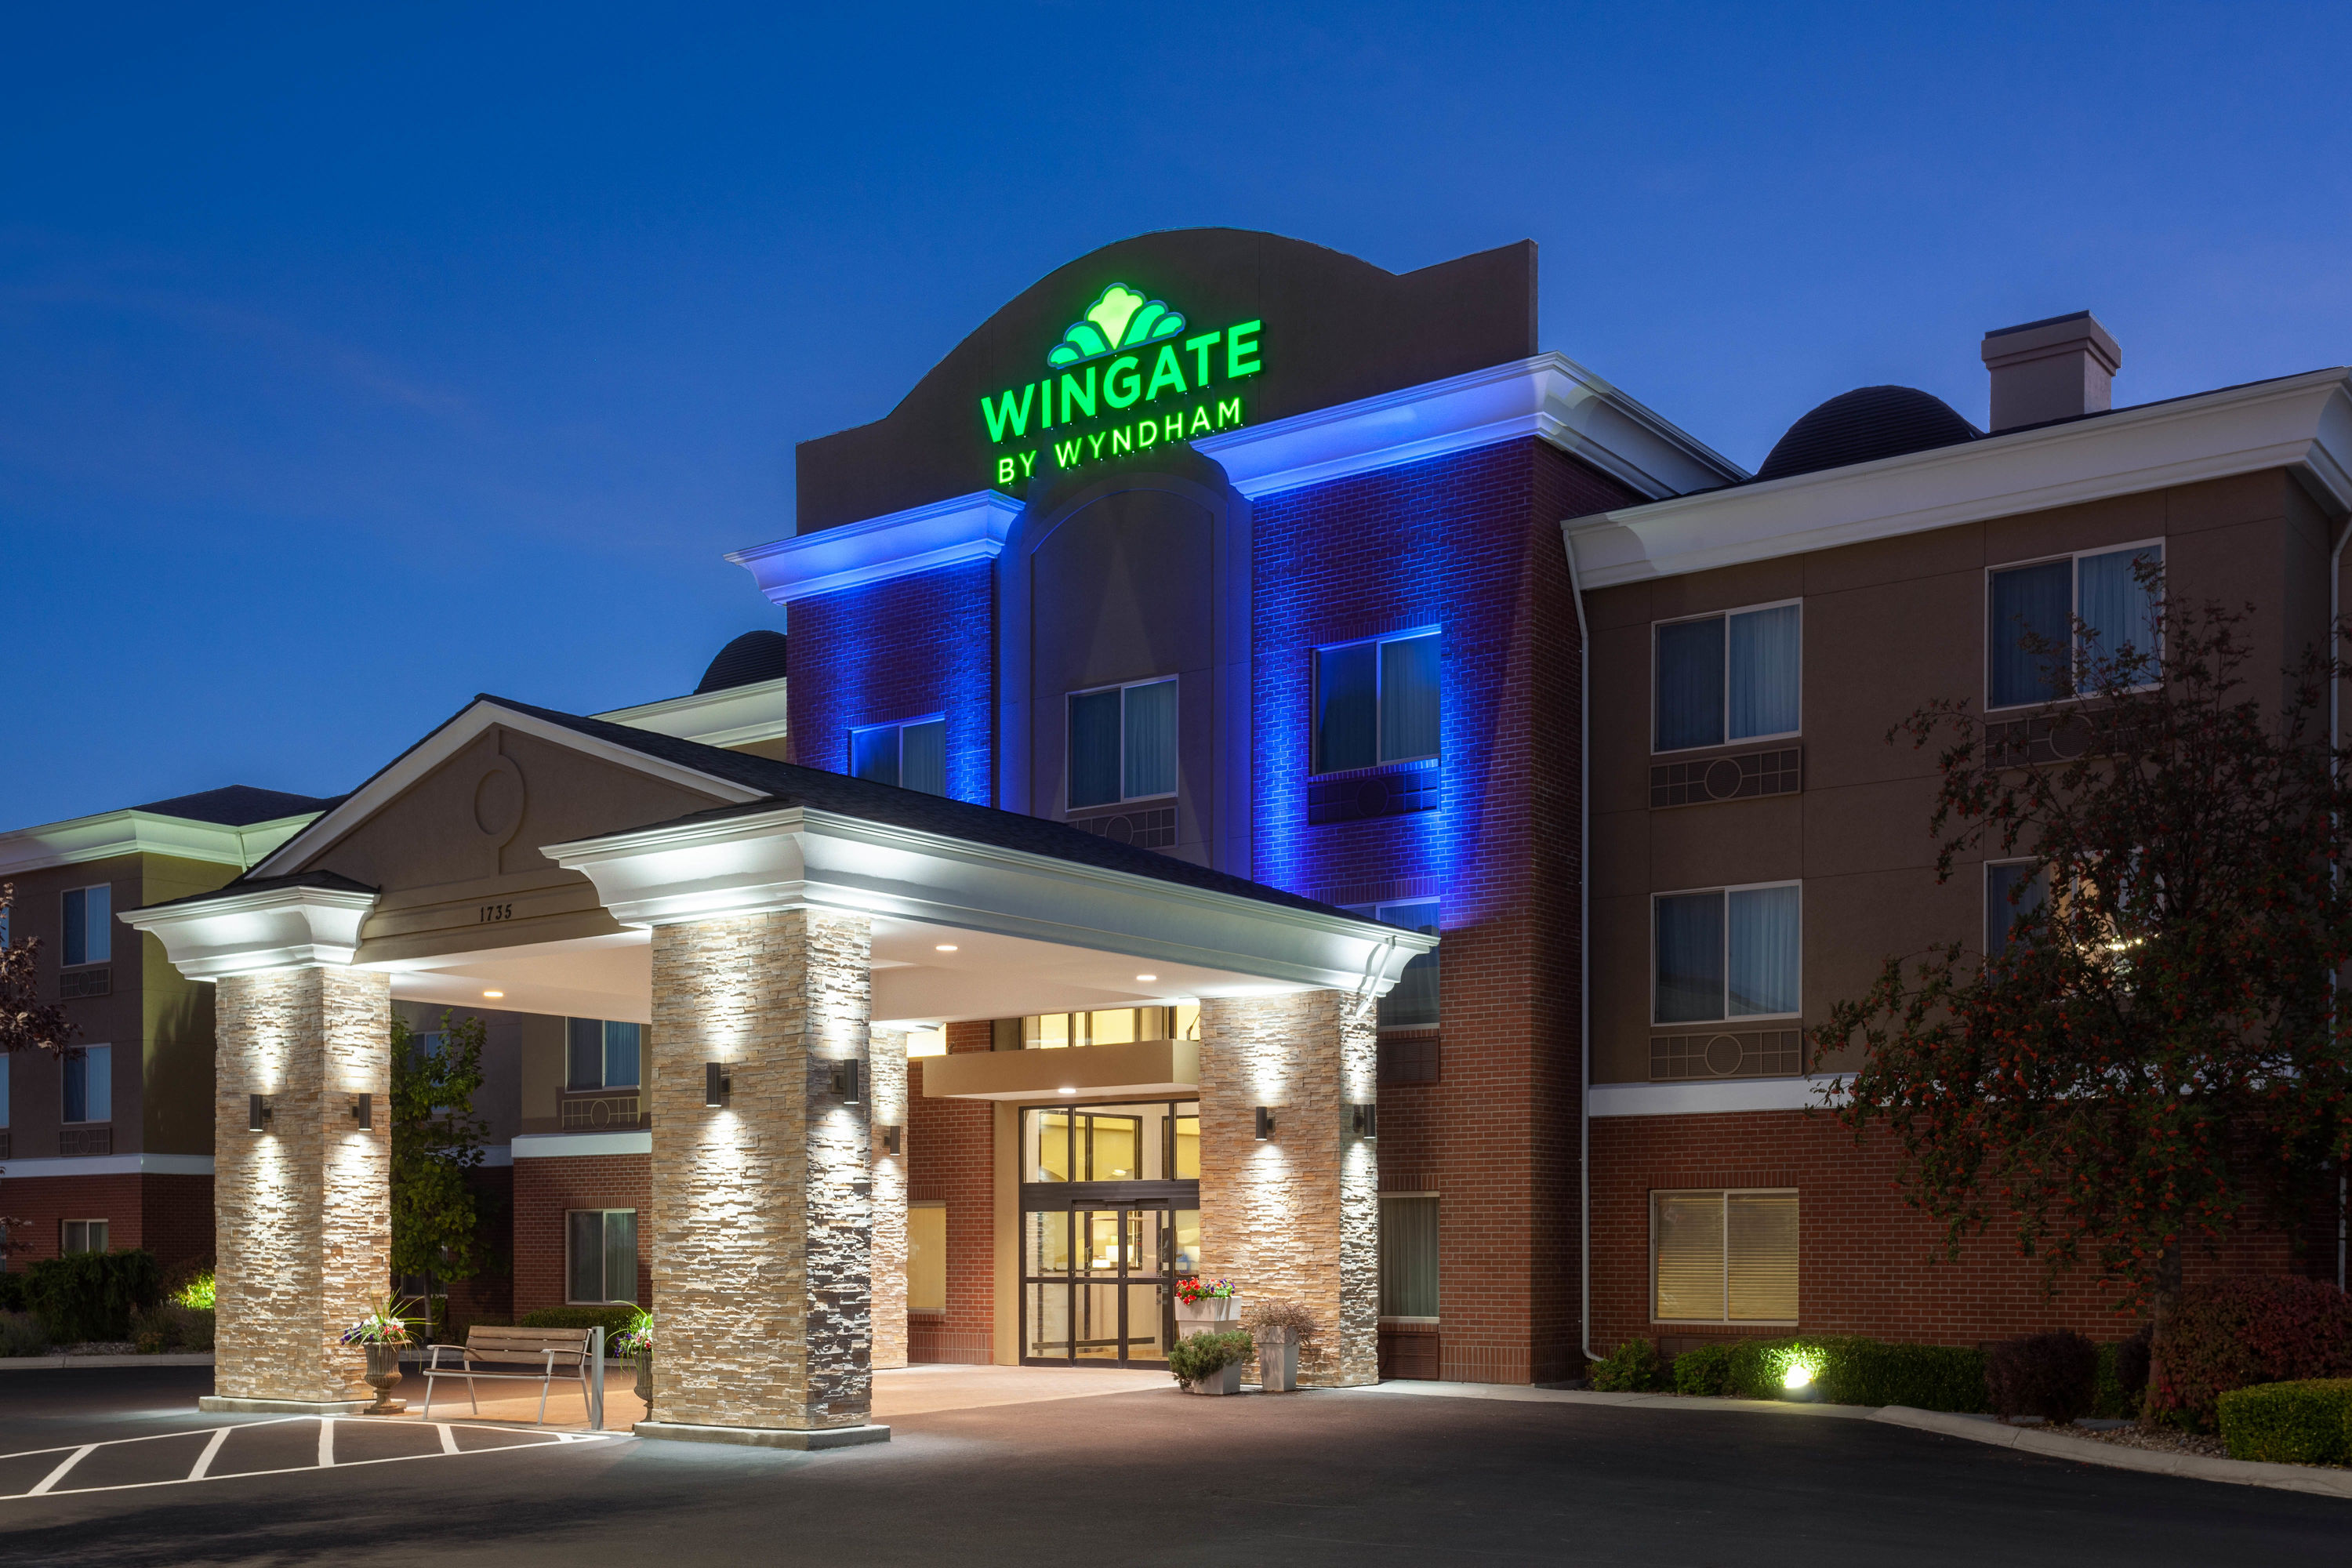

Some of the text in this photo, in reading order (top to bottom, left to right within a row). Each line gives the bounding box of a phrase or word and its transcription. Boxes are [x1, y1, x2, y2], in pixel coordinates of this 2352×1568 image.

[981, 319, 1261, 444] WINGATE
[998, 397, 1240, 485] BY WYNDHAM
[480, 903, 512, 922] 1735
